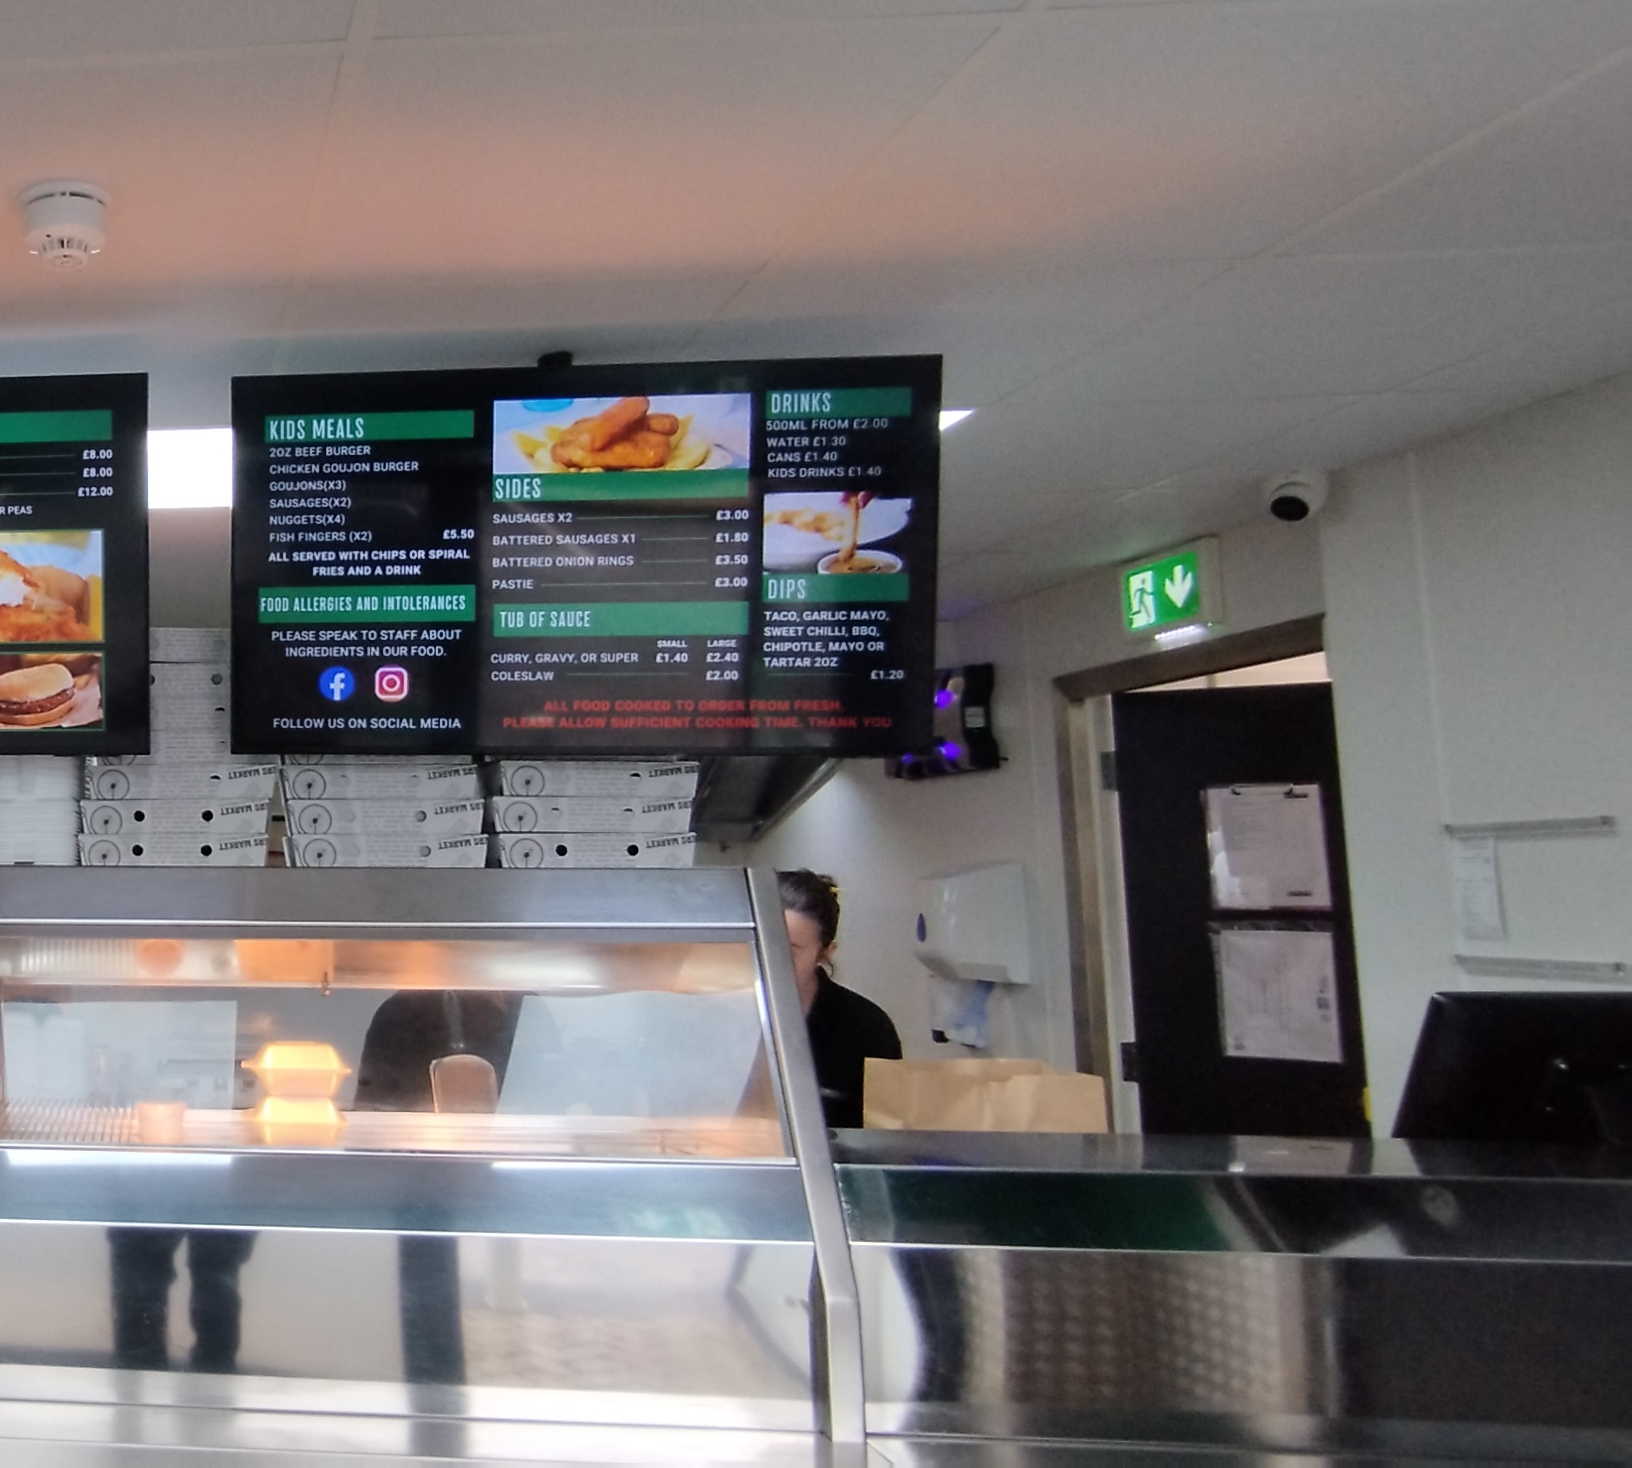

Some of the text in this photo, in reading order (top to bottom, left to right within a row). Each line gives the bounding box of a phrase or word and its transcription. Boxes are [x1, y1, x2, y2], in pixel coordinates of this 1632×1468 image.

[771, 393, 832, 413] DRINKS
[269, 418, 365, 440] KIDS MEALS
[811, 419, 849, 430] FROM
[766, 436, 810, 447] WATER
[82, 449, 113, 461] £8.00
[294, 445, 371, 457] BEEF BURGER
[82, 467, 114, 478] £8.00
[269, 461, 419, 474] CHICKEN GOUJON BURGER
[767, 467, 845, 478] KIDS DRINKS
[77, 486, 114, 498] £12.00
[269, 480, 347, 492] GOUJONS(X3)
[494, 478, 542, 498] SIDES
[269, 497, 352, 509] SAUSAGES(X2)
[7, 505, 33, 516] PEAS
[492, 509, 750, 524] SAUSAGES X2 £3.00
[269, 514, 346, 526] NUGGETS(X4)
[269, 528, 475, 543] FISH FINGERS (X2) £5.50
[492, 532, 749, 546] BATTERED SAUSAGES X1 £1.80
[268, 549, 471, 562] ALL SERVED WITH CHIPS OR SPIRAL
[492, 554, 749, 568] BATTERED ONION RINGS £3.50
[312, 565, 421, 576] FRIES AND A DRINK
[492, 576, 748, 590] PASTIE £3.00
[768, 579, 806, 599] DIPS
[260, 595, 466, 612] FOOD ALLERGIES AND INTOLERANCES
[499, 611, 591, 628] TUB OF SAUCE
[763, 611, 801, 622] TACO,
[802, 610, 848, 622] GARLIC
[271, 629, 462, 642] PLEASE SPEAK TO STAFF ABOUT
[763, 626, 805, 638] SWEET
[285, 646, 365, 657] INGREDIENTS
[366, 646, 380, 657] IN
[382, 645, 408, 657] OUR
[763, 641, 885, 653] CHIPOTLE, MAYO OR
[580, 652, 598, 664] OR
[599, 652, 639, 663] SUPER
[655, 652, 689, 663] £1.40
[705, 652, 739, 663] £2.40
[763, 657, 812, 668] TARTAR
[490, 670, 739, 682] COLESLAW £2.00
[272, 717, 462, 729] FOLLOW US ON SOCIAL MEDIA
